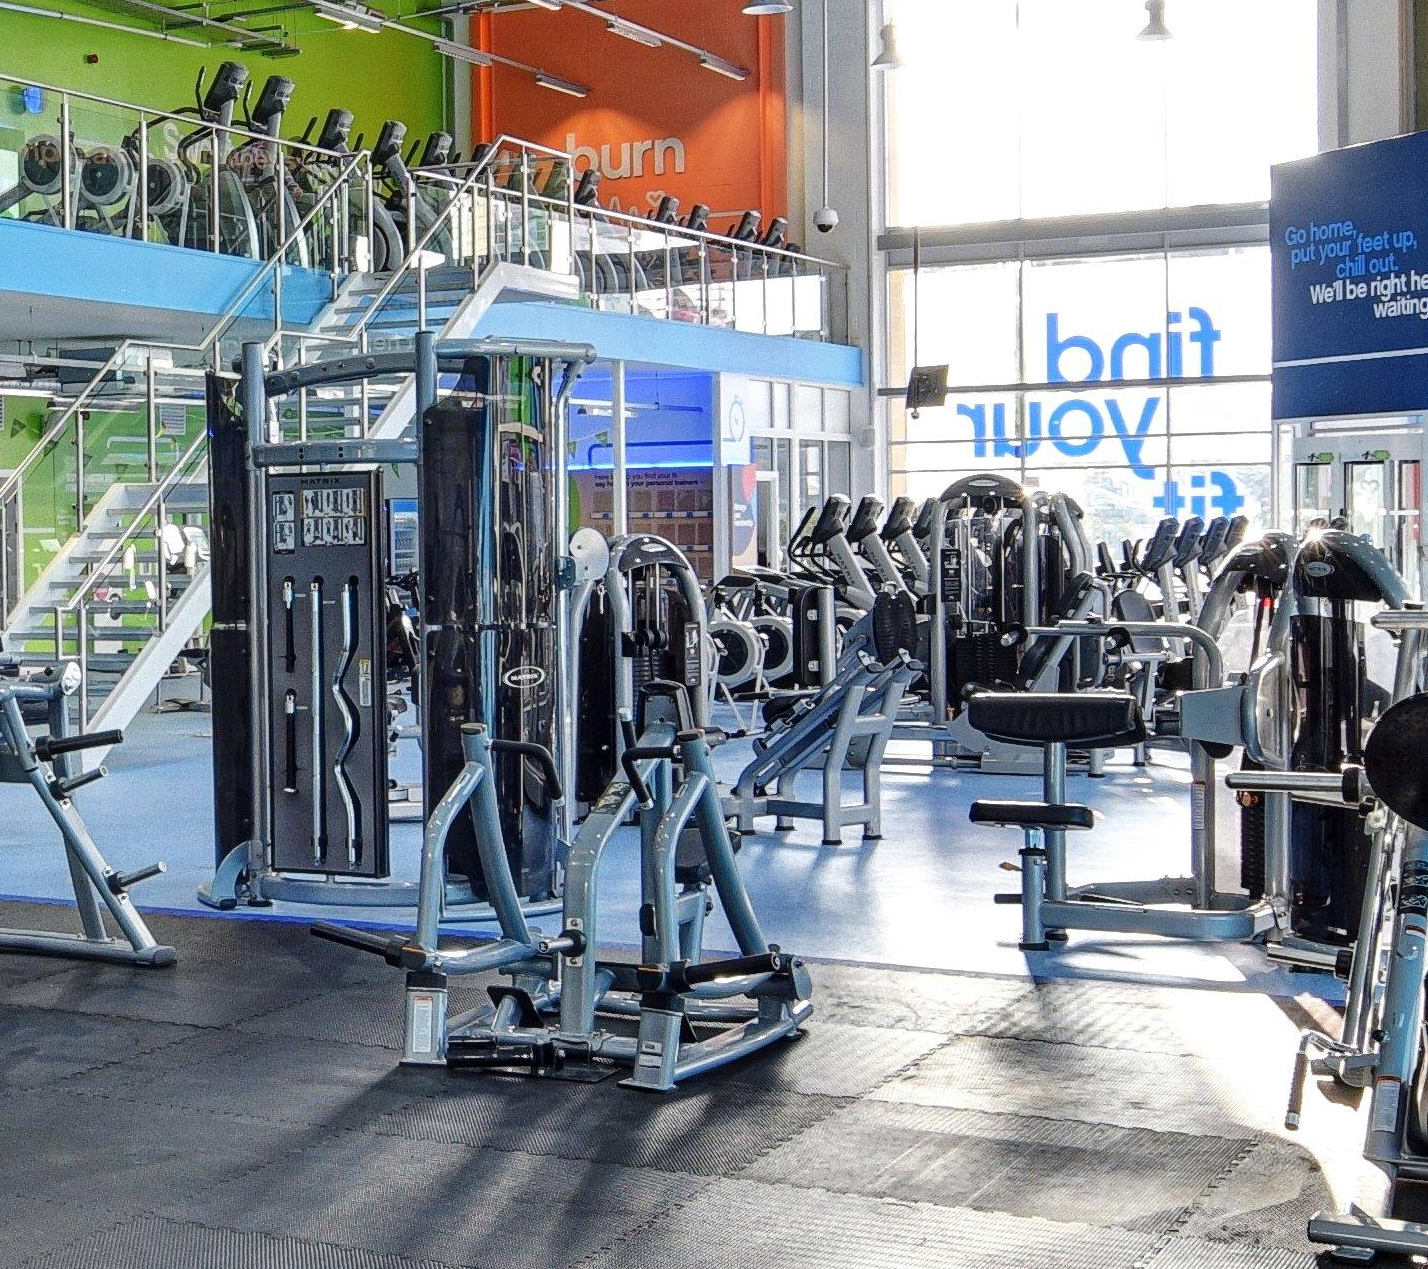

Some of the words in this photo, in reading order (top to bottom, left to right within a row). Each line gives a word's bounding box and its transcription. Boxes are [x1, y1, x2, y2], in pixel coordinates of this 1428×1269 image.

[566, 132, 685, 180] burn
[1285, 226, 1307, 246] Go
[1310, 221, 1357, 241] home,
[1291, 243, 1316, 270] put
[1319, 241, 1352, 266] your
[1357, 232, 1390, 254] feet
[1392, 231, 1418, 253] up,
[1336, 254, 1366, 278] chill
[1346, 278, 1368, 300] be
[1370, 272, 1408, 301] right
